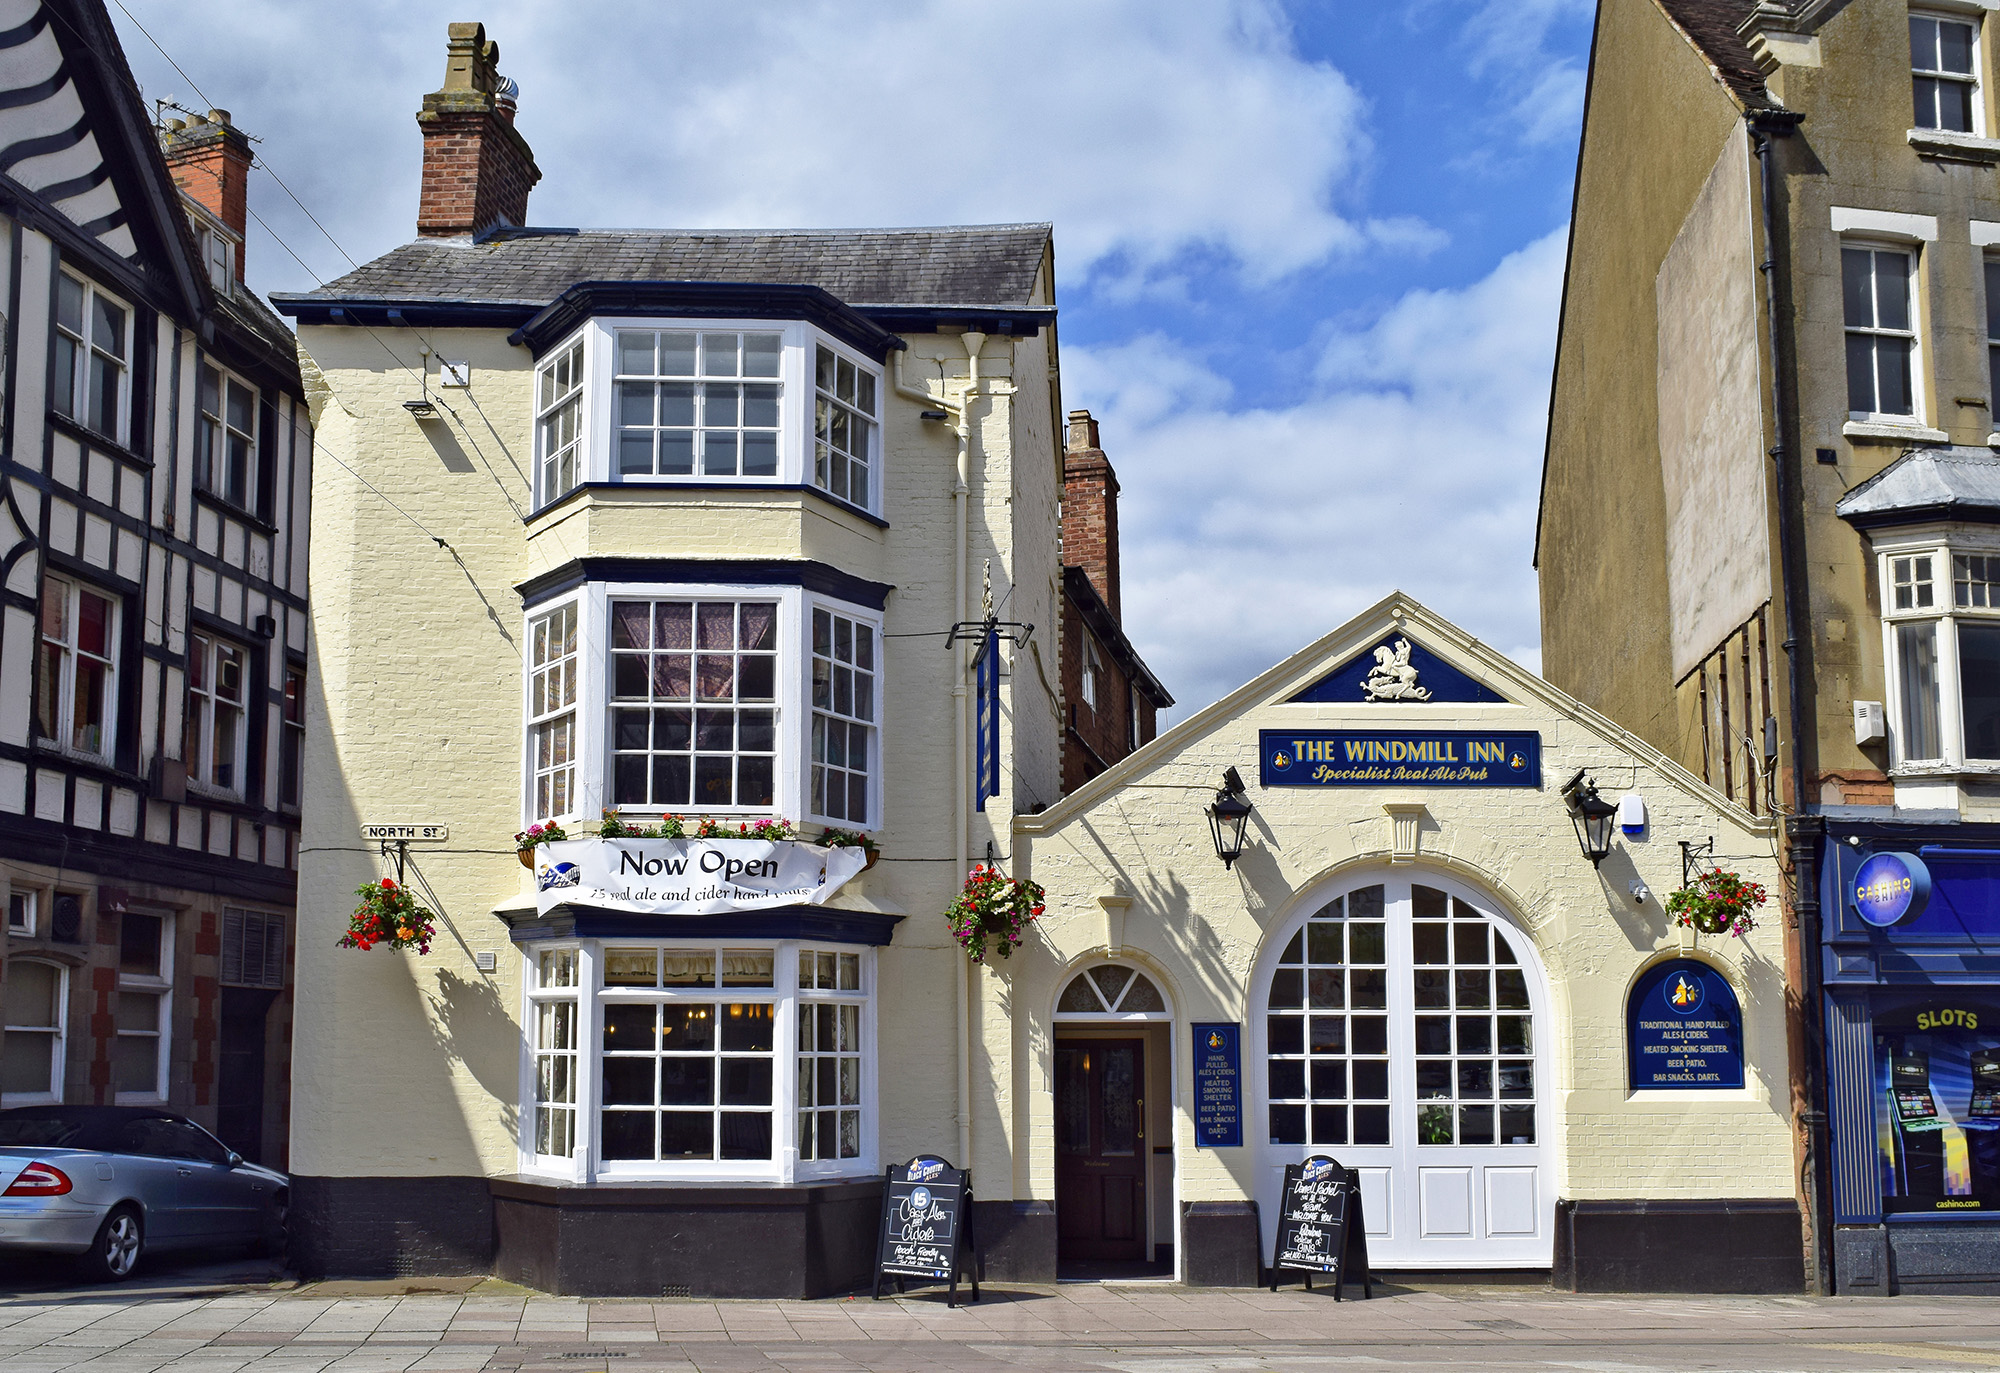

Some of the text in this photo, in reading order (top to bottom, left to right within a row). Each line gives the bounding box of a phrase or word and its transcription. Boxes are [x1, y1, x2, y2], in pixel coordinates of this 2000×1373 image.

[1292, 740, 1505, 763] THE WINDMILL INN
[1312, 764, 1488, 784] Specialist Real Ale Pub
[369, 827, 438, 837] NORTH ST
[620, 850, 778, 882] Now Open
[610, 887, 631, 901] real
[635, 887, 657, 901] ale
[661, 887, 690, 901] and
[695, 885, 730, 901] cider
[734, 886, 769, 900] hand
[1857, 877, 1911, 899] CASHINO
[1639, 1021, 1730, 1029] TRADITIONAL HAND PULLED
[1916, 1008, 1978, 1030] SLOTS
[1662, 1031, 1681, 1039] ALES
[1643, 1045, 1669, 1054] HEATED
[1670, 1045, 1699, 1053] SMOKING
[1666, 1060, 1685, 1068] BEER
[907, 1163, 944, 1181] BLACK COUNTRY
[913, 1192, 927, 1207] 15
[1936, 1199, 1981, 1208] cashino.com
[899, 1197, 928, 1222] Cask
